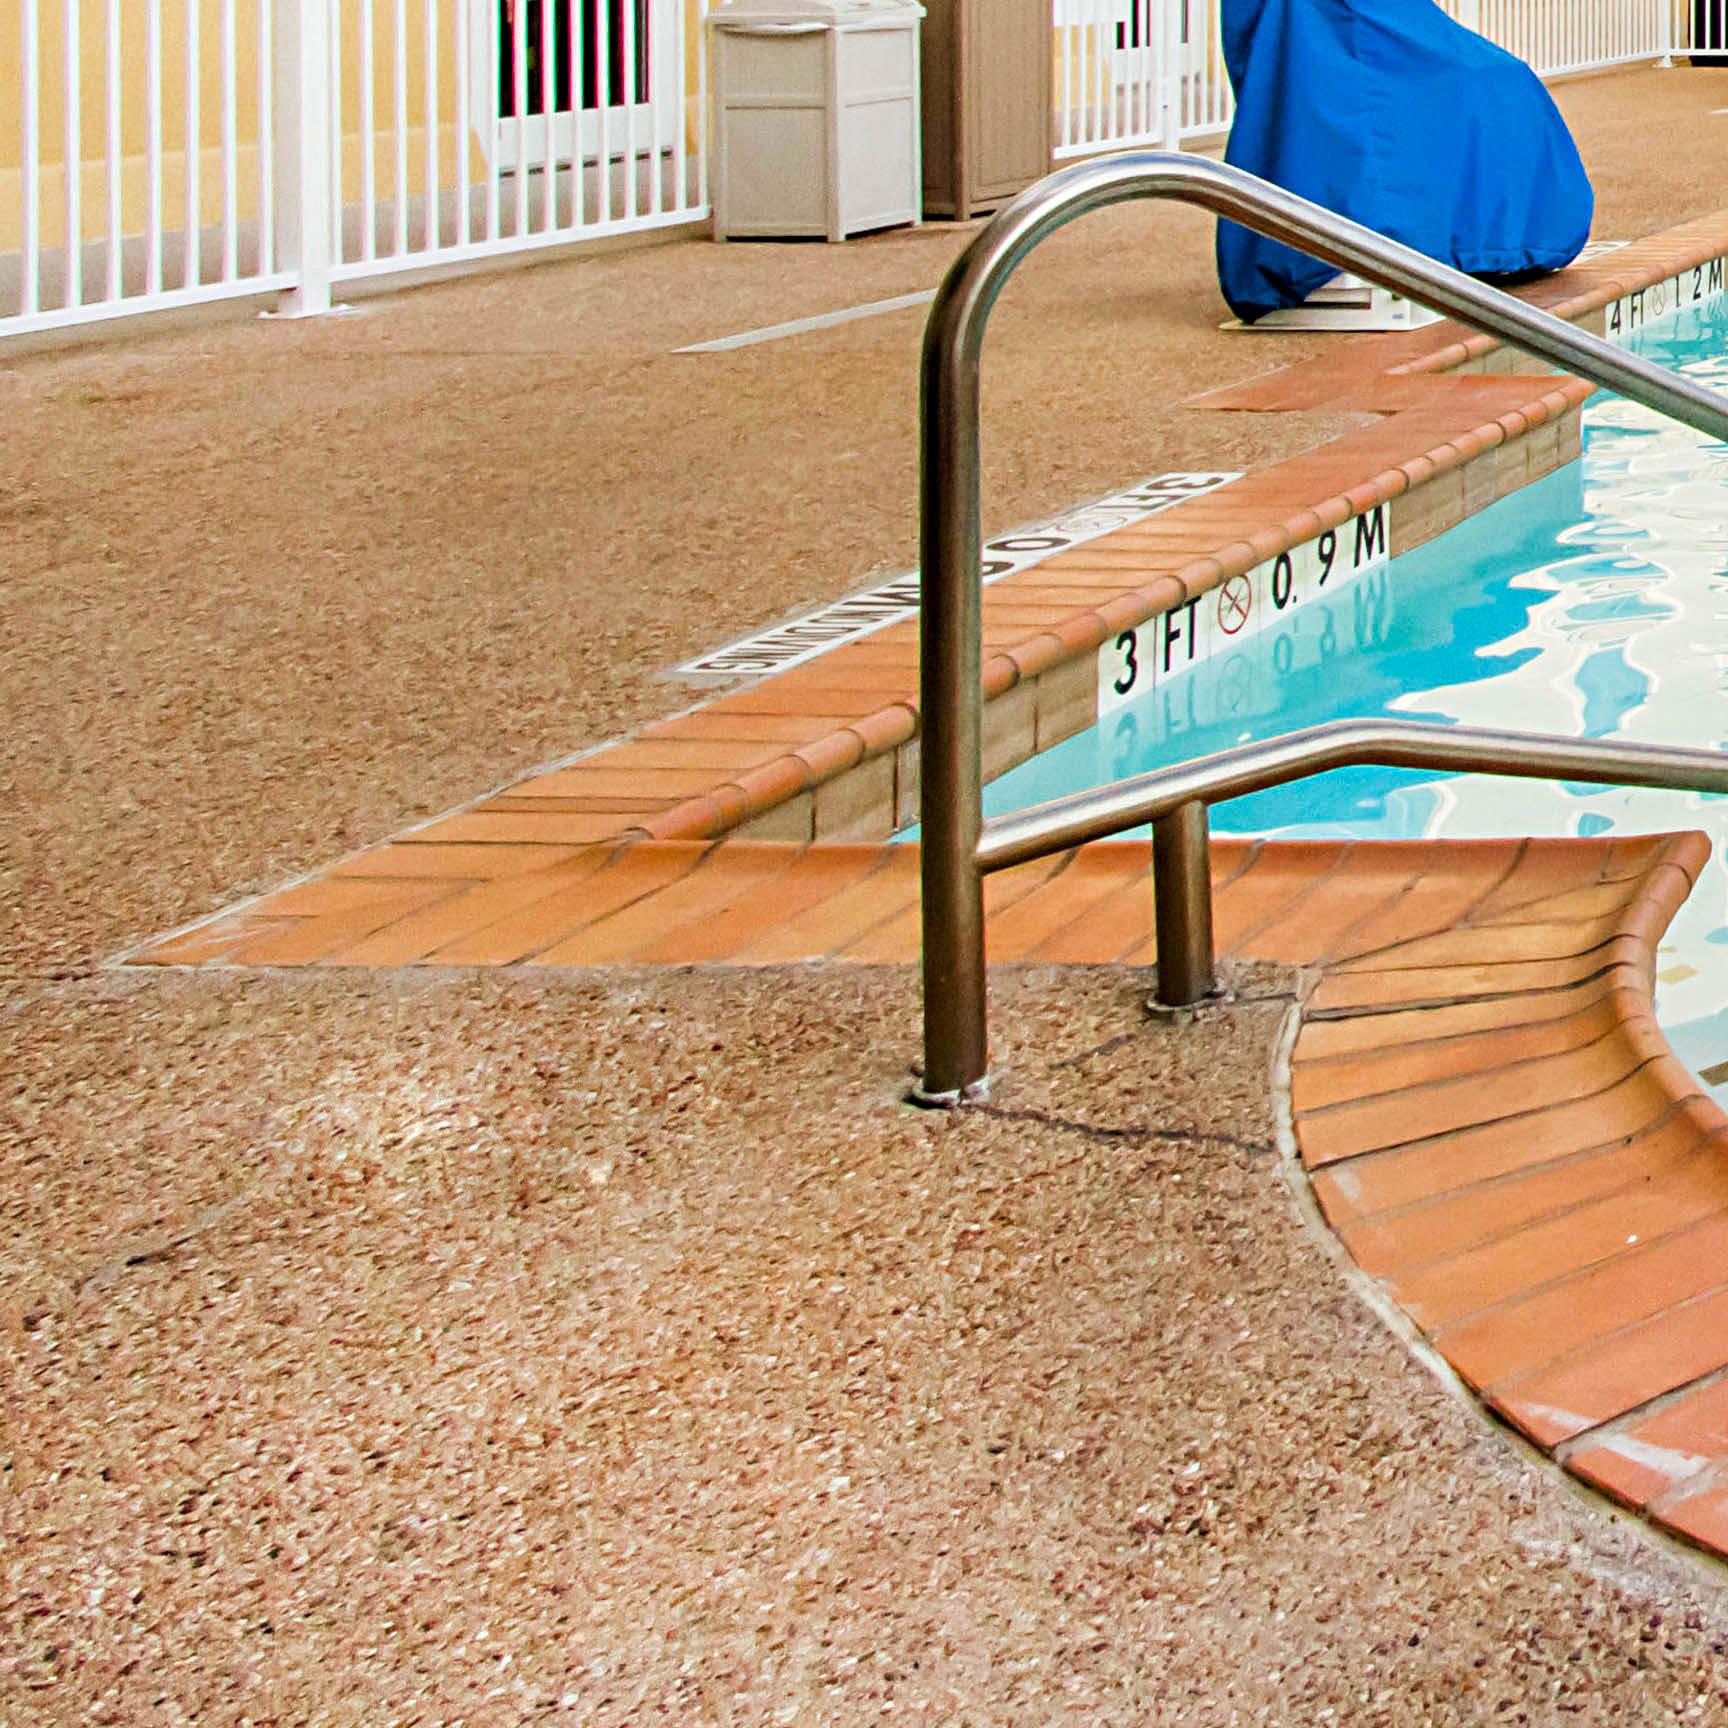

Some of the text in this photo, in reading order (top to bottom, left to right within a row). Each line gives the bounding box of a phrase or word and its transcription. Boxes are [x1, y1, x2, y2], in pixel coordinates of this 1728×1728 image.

[1609, 299, 1621, 335] 4
[1630, 287, 1646, 329] FT
[1707, 255, 1723, 294] M
[1113, 629, 1138, 696] 3
[1163, 595, 1202, 673] FT
[1353, 505, 1385, 569] M
